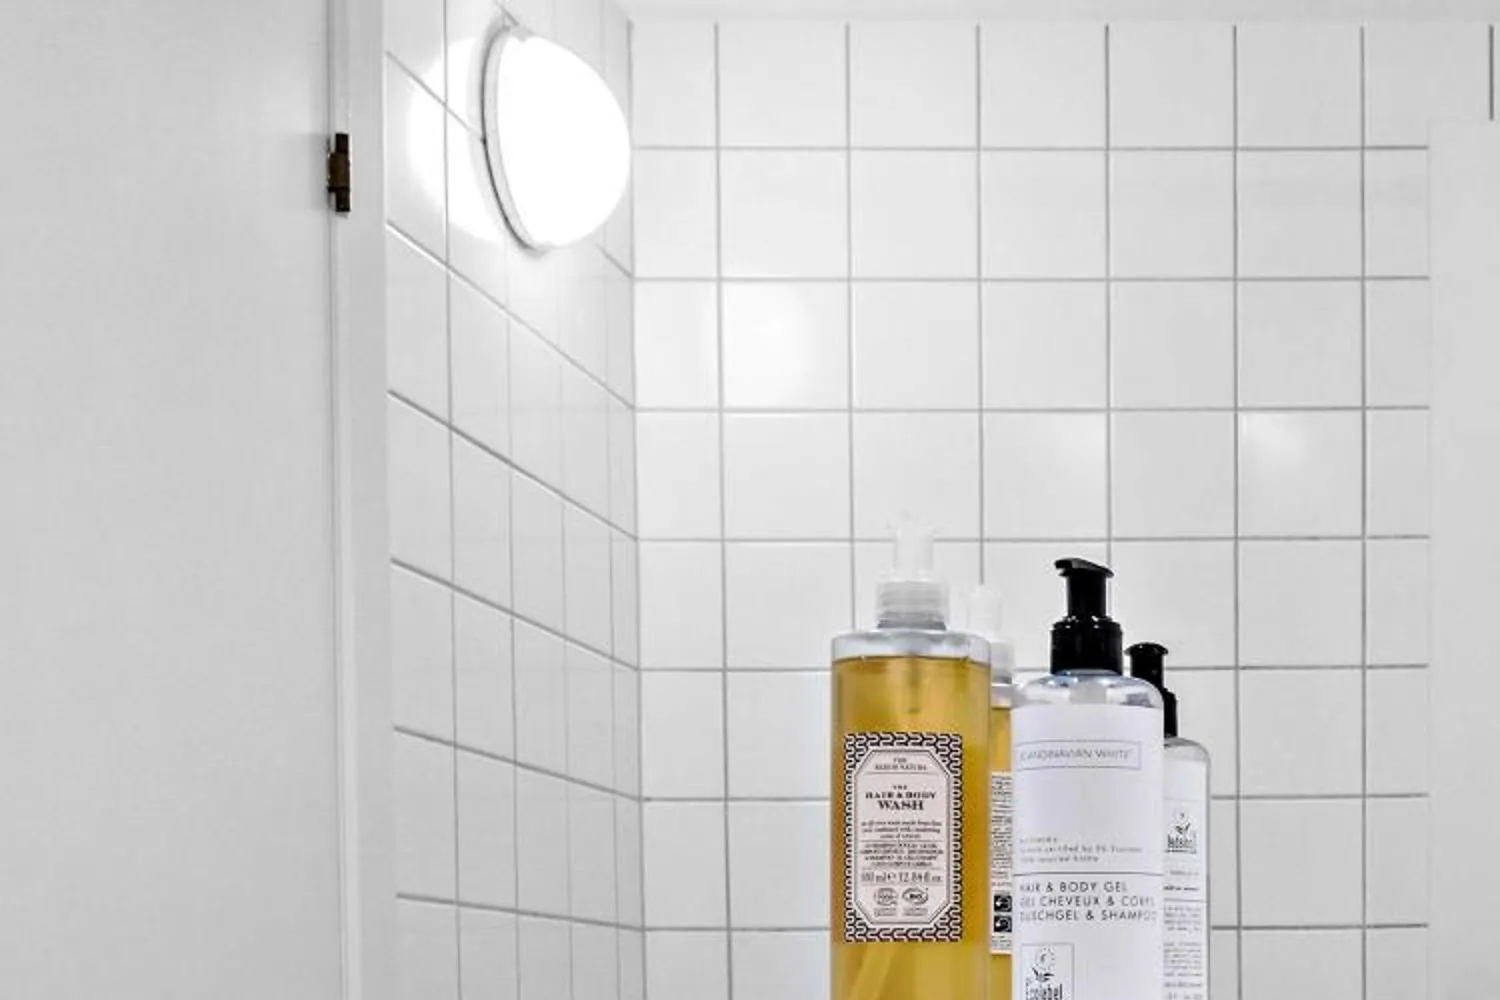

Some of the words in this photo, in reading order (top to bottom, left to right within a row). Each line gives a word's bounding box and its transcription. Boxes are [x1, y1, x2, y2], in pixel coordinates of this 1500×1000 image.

[865, 791, 894, 799] HAIR
[905, 791, 936, 799] BODY
[878, 800, 924, 810] WASH
[1046, 881, 1054, 892] &
[1059, 881, 1097, 892] BODY
[1103, 881, 1128, 892] GEL
[1040, 895, 1100, 907] CHEVEUX
[1107, 895, 1116, 907] &
[1085, 909, 1095, 920] &
